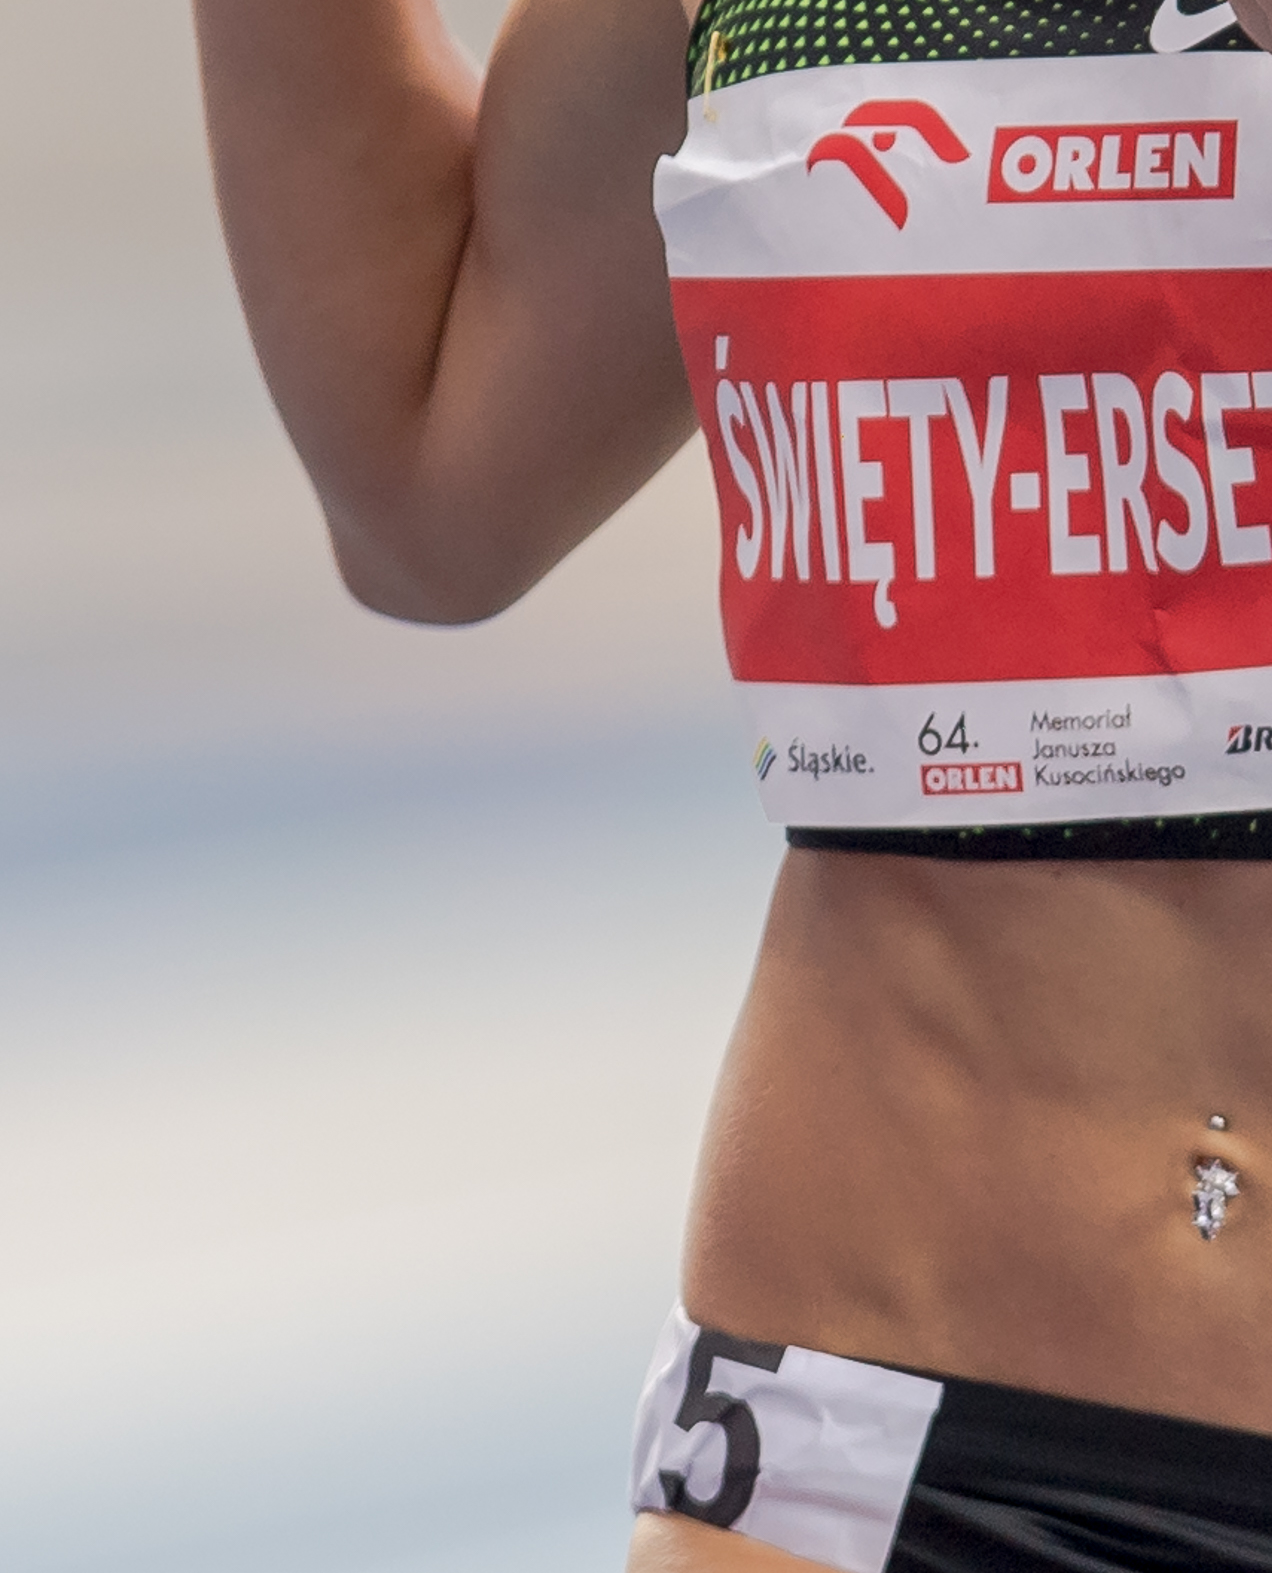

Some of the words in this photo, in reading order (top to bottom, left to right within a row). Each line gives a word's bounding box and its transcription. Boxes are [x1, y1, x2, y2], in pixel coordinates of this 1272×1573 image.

[1000, 131, 1220, 195] ORLEN
[917, 711, 980, 756] 64.
[1030, 704, 1133, 732] Memoriał
[787, 738, 875, 781] Śląskie.
[1032, 740, 1117, 760] Janusza
[924, 765, 1018, 793] ORLEN
[1033, 758, 1187, 787] Kusocińskiego
[658, 1326, 788, 1530] 5
